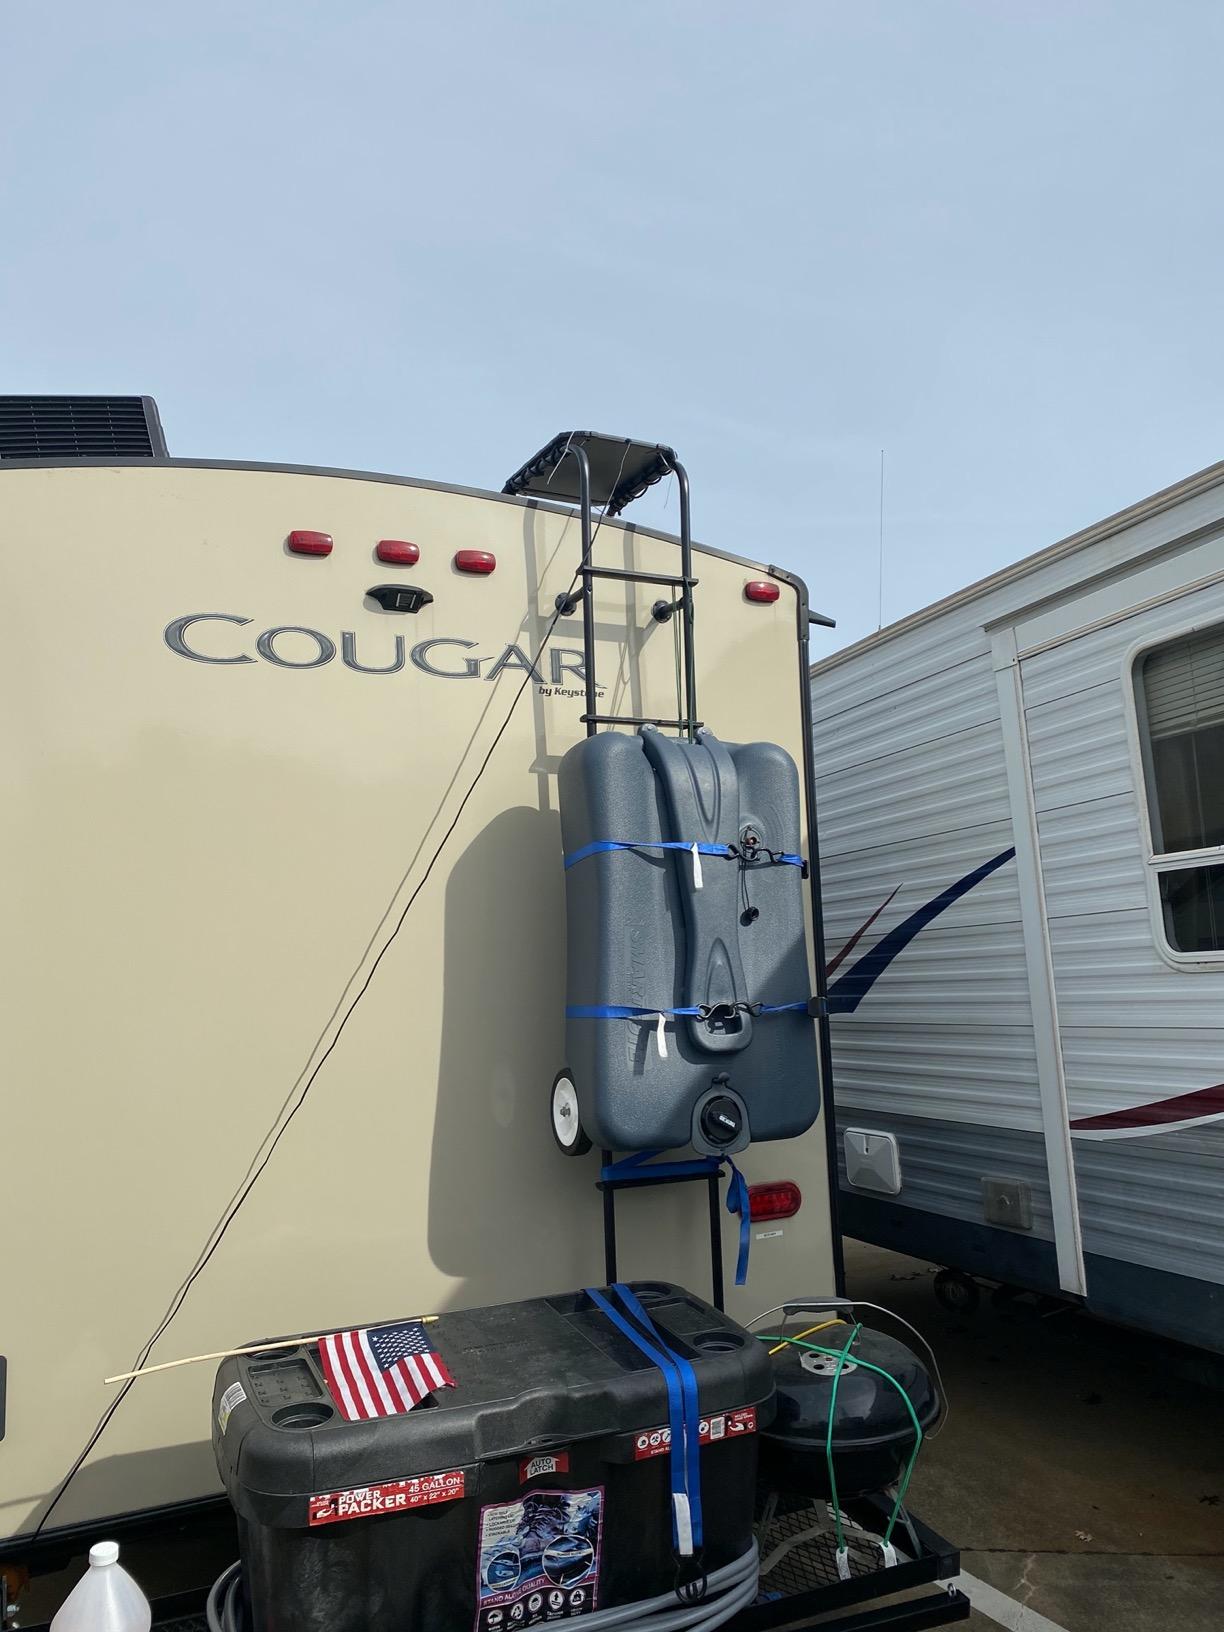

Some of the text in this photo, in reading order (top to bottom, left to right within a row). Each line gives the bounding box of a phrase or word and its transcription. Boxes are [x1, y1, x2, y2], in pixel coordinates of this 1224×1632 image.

[163, 612, 607, 689] COUGAR
[538, 686, 552, 697] by
[531, 1457, 552, 1469] AUTO
[408, 1476, 461, 1494] 45 GALLON
[338, 1489, 381, 1505] POWER
[338, 1493, 407, 1516] PACKER
[522, 1577, 545, 1592] QUALITY
